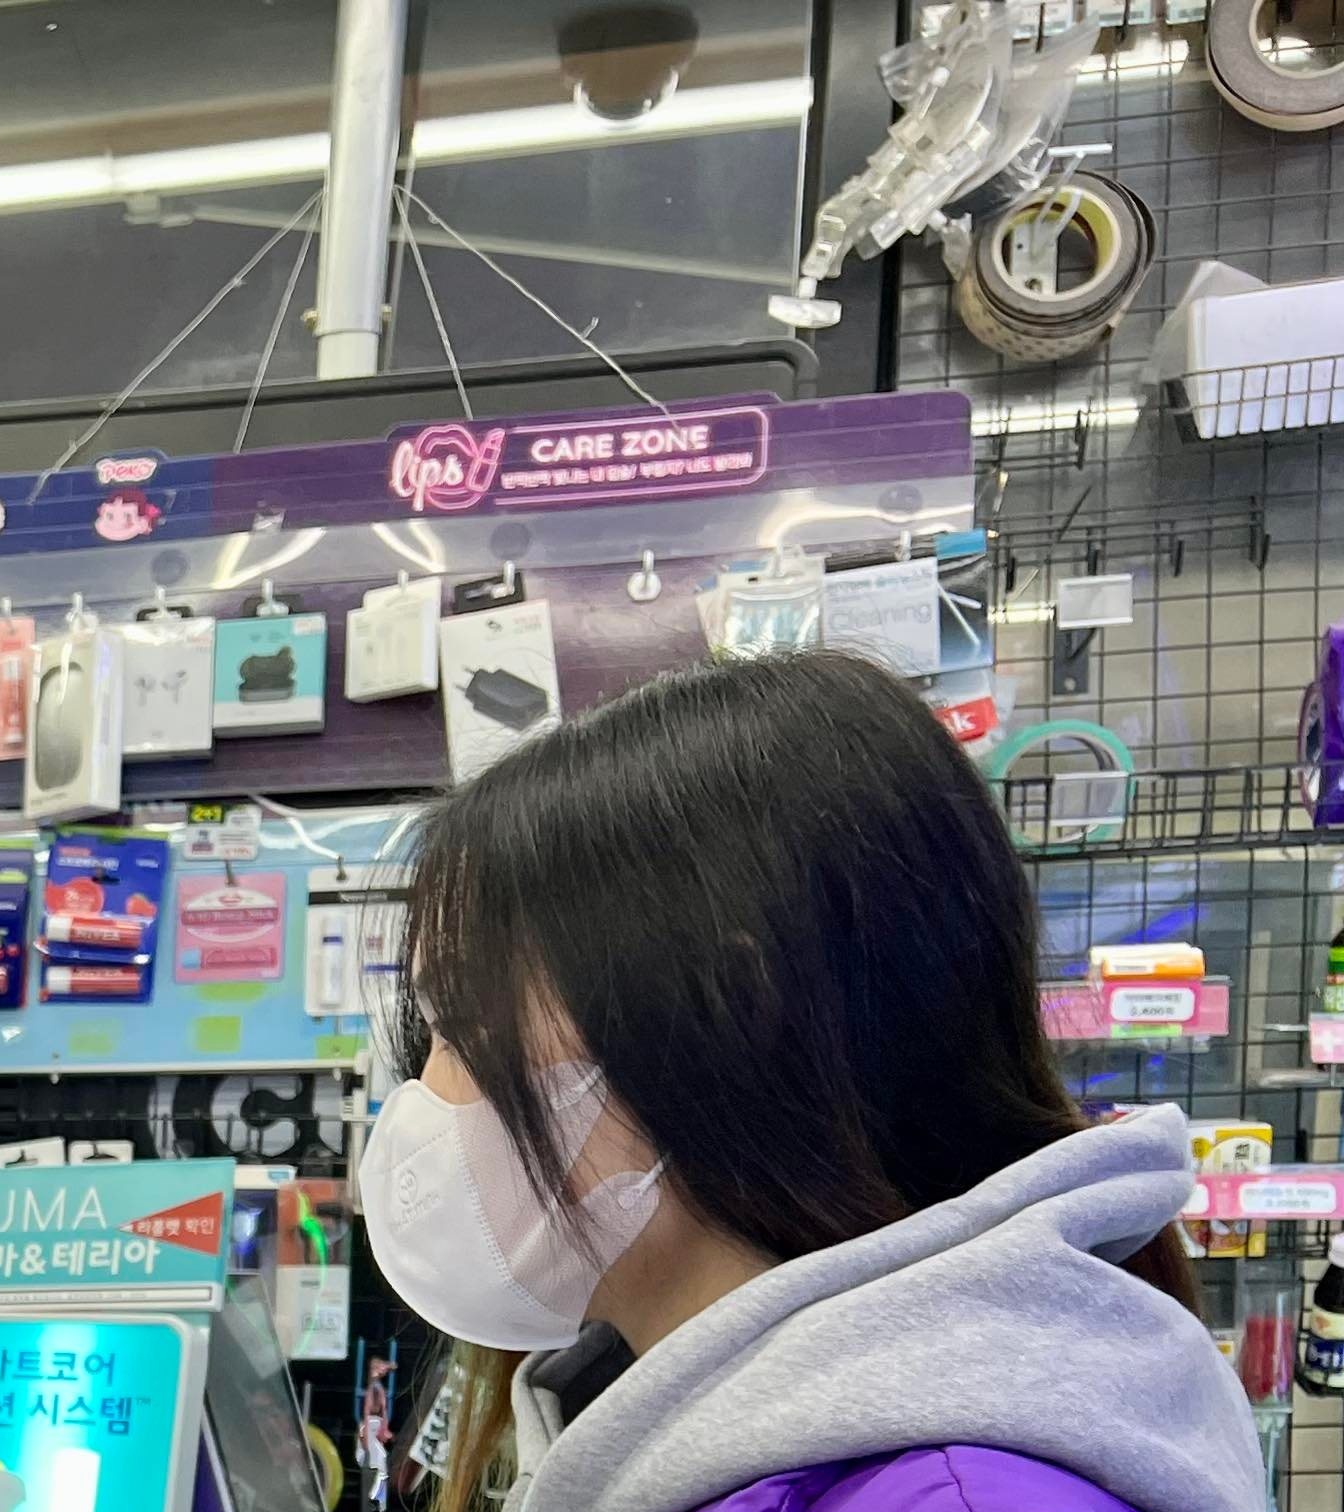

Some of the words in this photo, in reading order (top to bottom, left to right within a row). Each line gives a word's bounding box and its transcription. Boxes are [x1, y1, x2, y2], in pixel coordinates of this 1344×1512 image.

[530, 434, 614, 462] CARE
[621, 426, 710, 455] ZONE
[392, 440, 464, 512] lips
